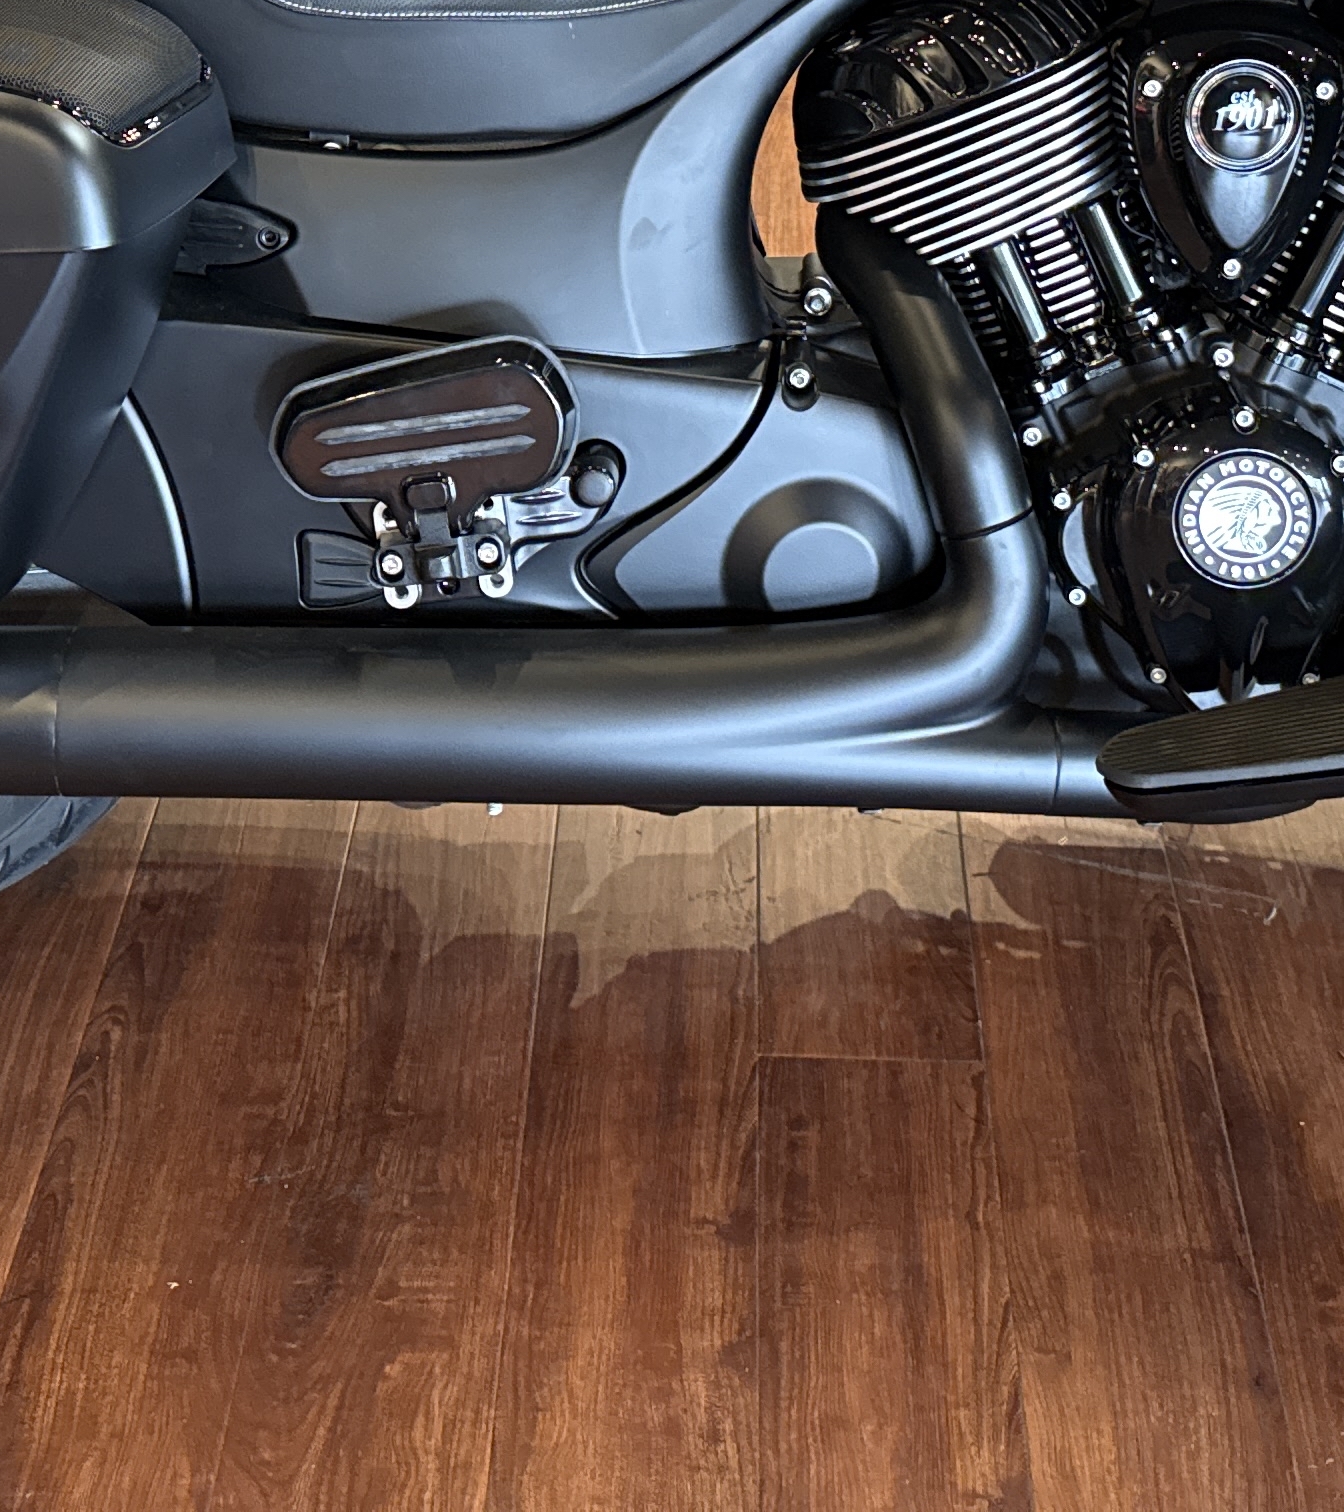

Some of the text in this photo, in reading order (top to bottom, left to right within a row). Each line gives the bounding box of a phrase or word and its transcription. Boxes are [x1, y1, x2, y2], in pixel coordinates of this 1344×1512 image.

[1211, 98, 1279, 131] 1901
[1182, 458, 1309, 560] INDIAN MOTORCYCLE
[1218, 561, 1267, 580] 1901
